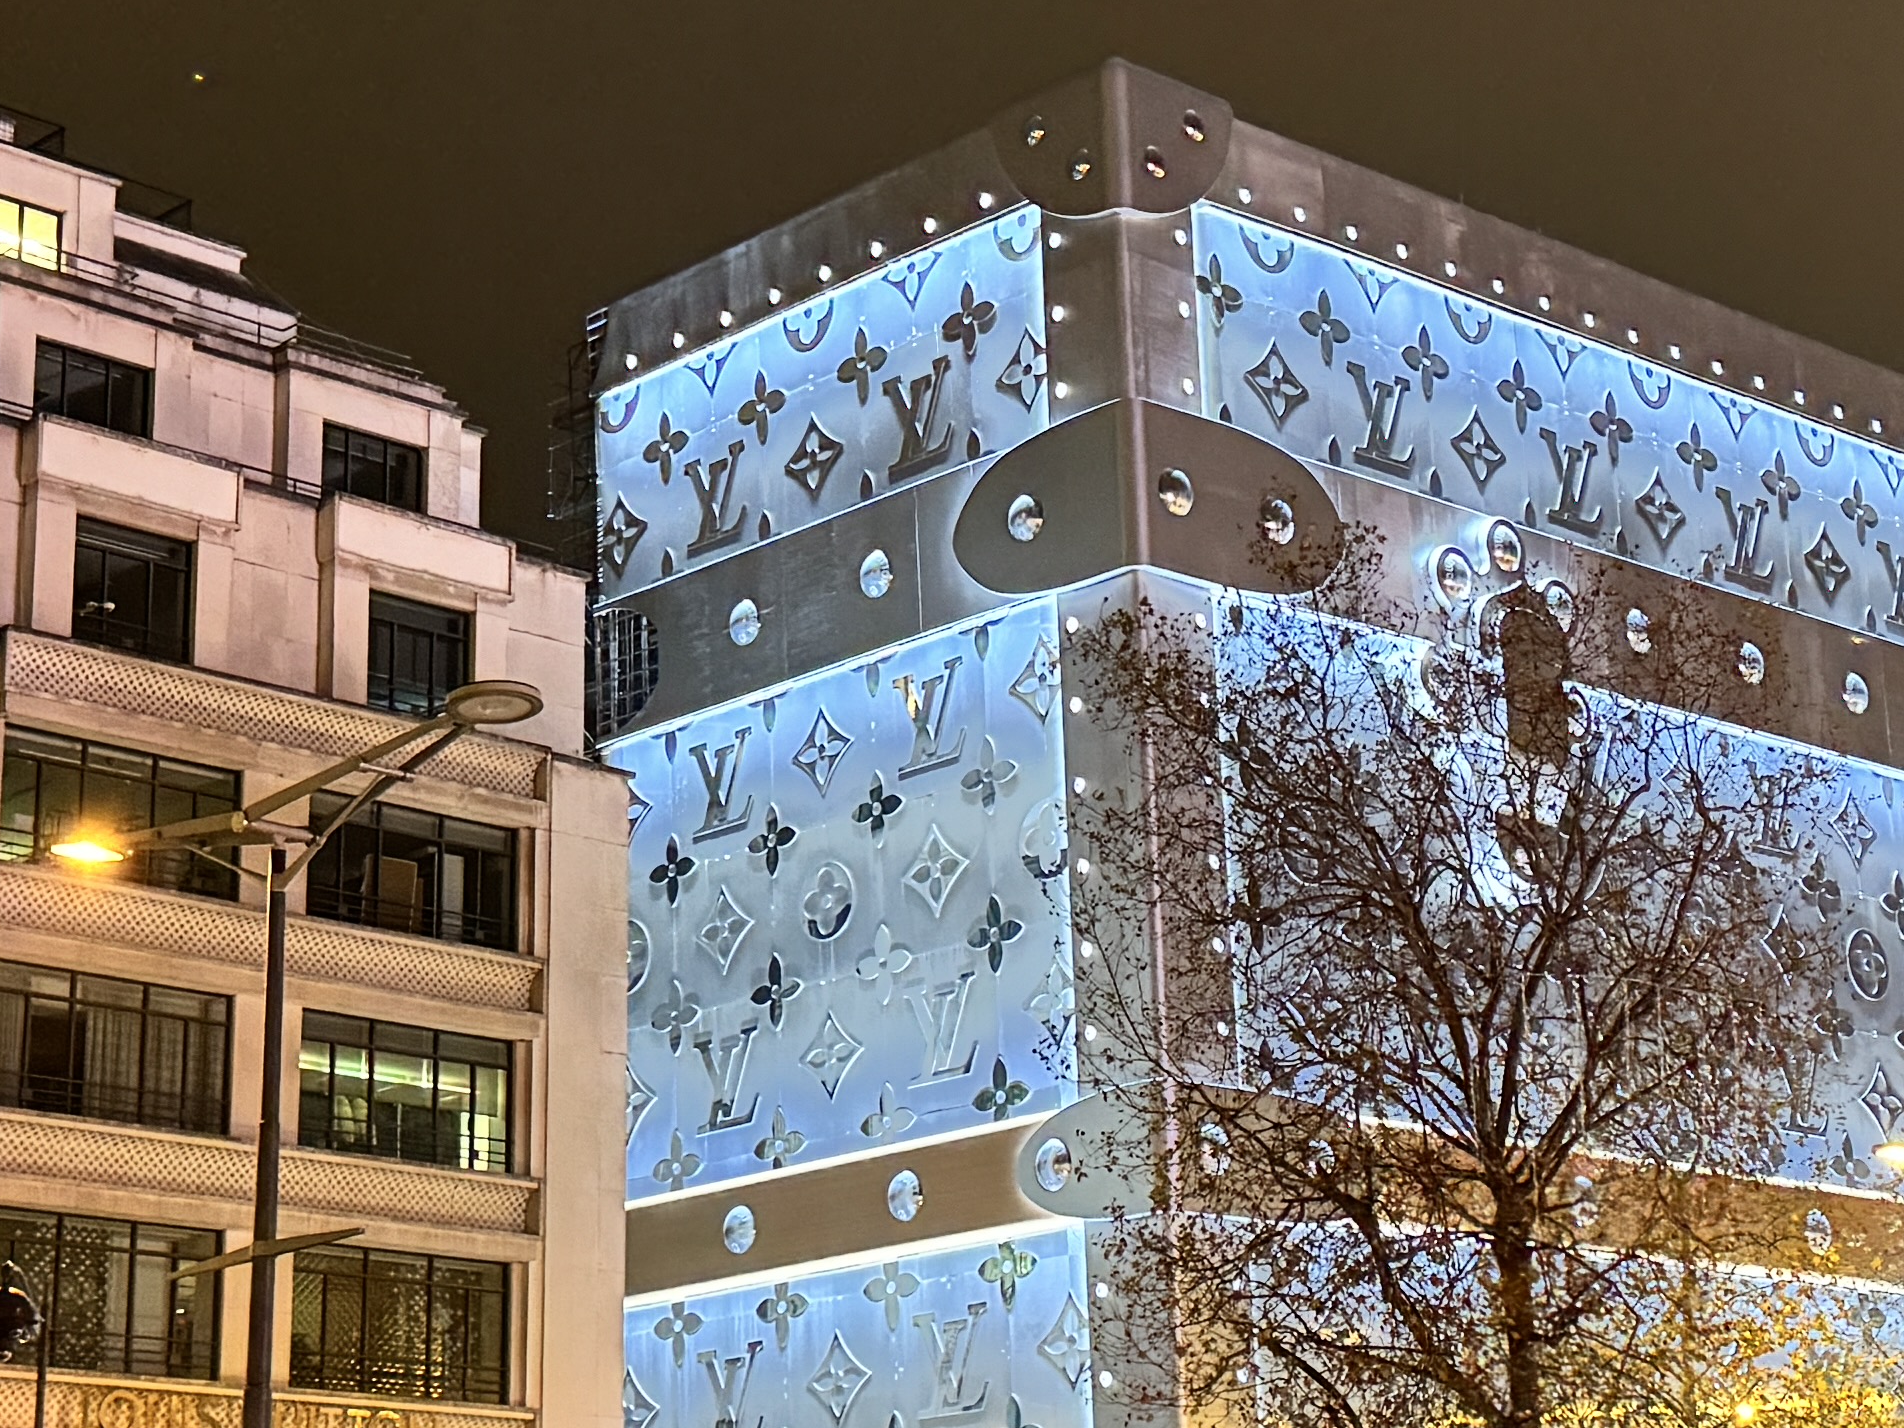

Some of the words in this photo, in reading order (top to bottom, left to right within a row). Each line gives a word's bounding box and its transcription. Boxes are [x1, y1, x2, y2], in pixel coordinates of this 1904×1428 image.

[882, 355, 955, 484] LV
[1346, 360, 1416, 474] LV
[684, 441, 750, 559] LV
[1539, 426, 1603, 533] LV
[1715, 486, 1776, 586] LV
[893, 656, 968, 781] LV
[689, 726, 755, 843] LV
[693, 1024, 760, 1138] LV
[902, 972, 980, 1089] LV
[912, 1301, 990, 1424] LV
